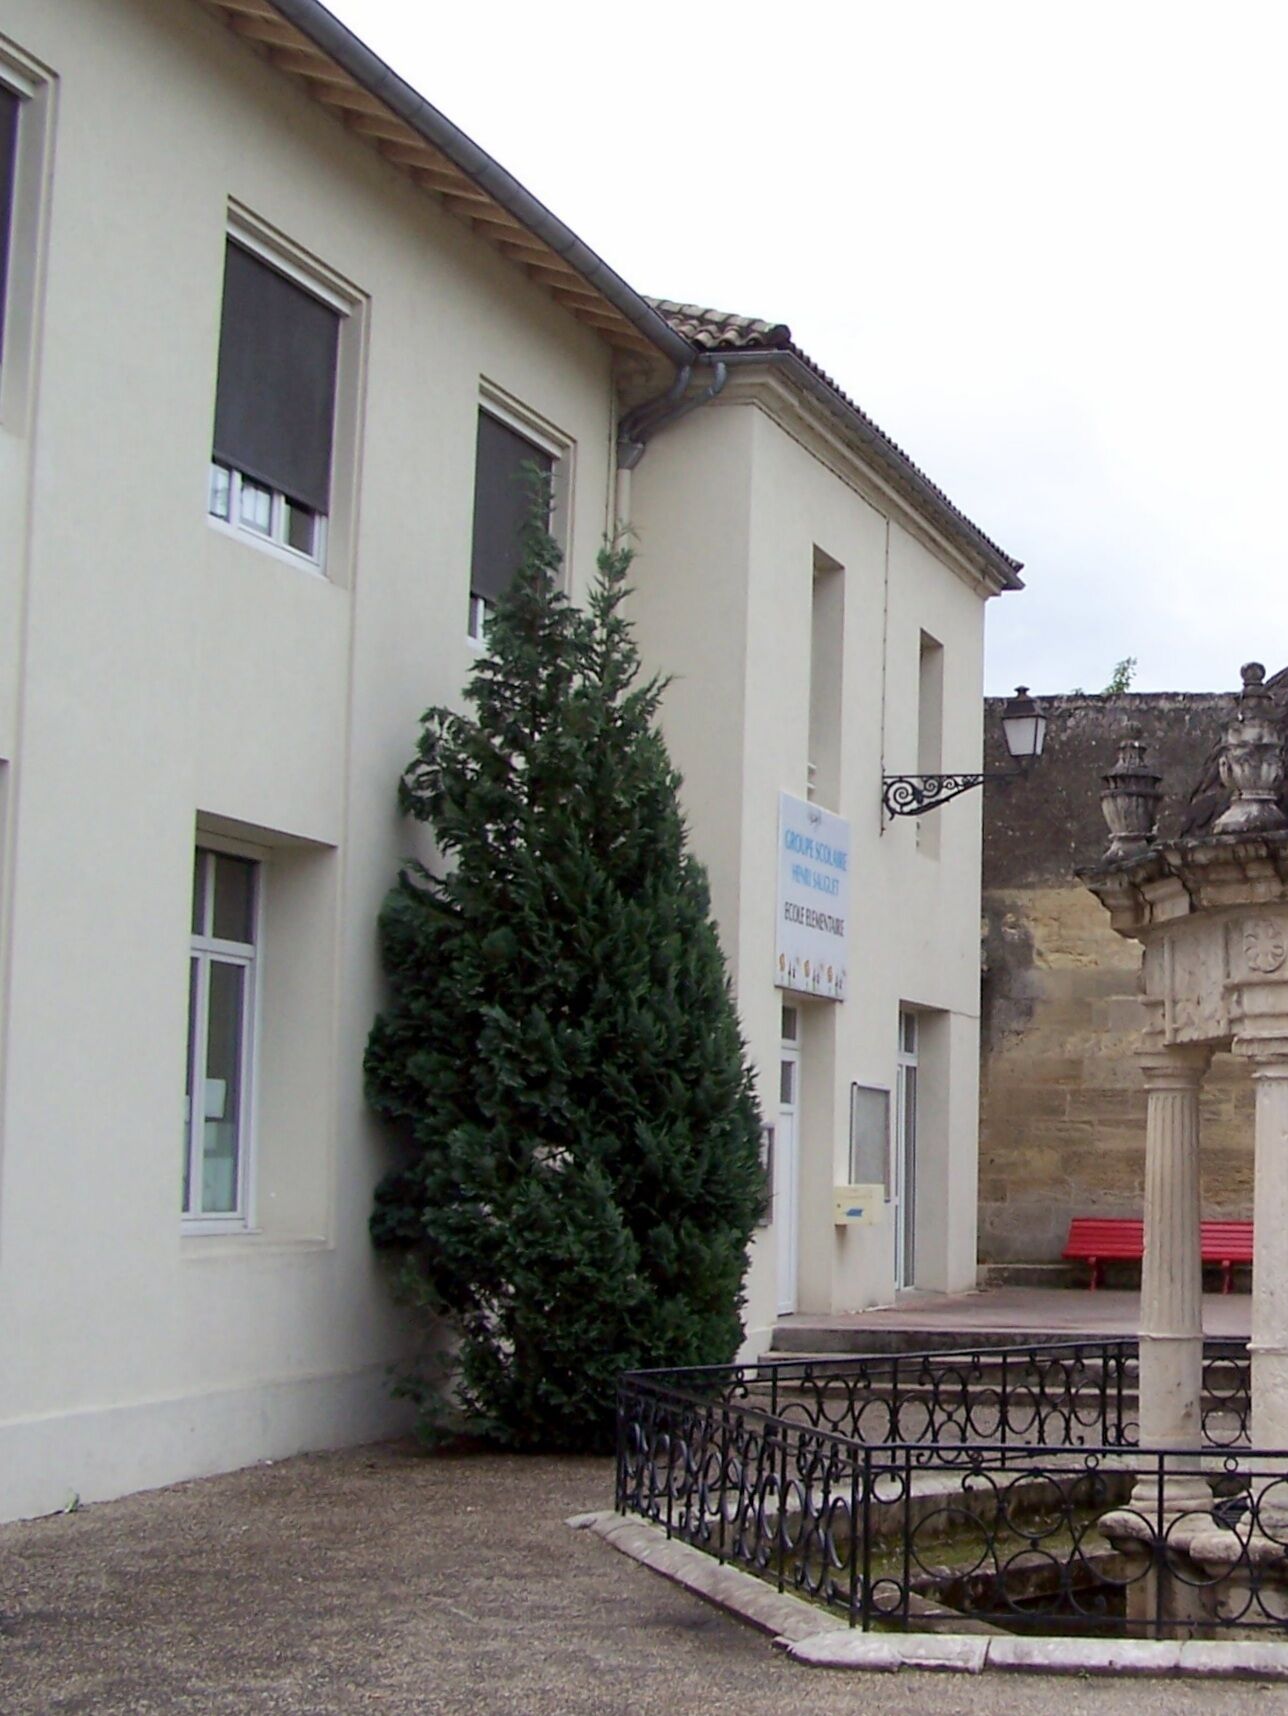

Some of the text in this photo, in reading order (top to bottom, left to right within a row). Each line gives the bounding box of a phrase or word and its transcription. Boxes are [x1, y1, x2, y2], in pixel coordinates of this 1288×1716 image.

[784, 828, 848, 872] GROUPE SCOLAIRE
[784, 901, 805, 926] ECOLE
